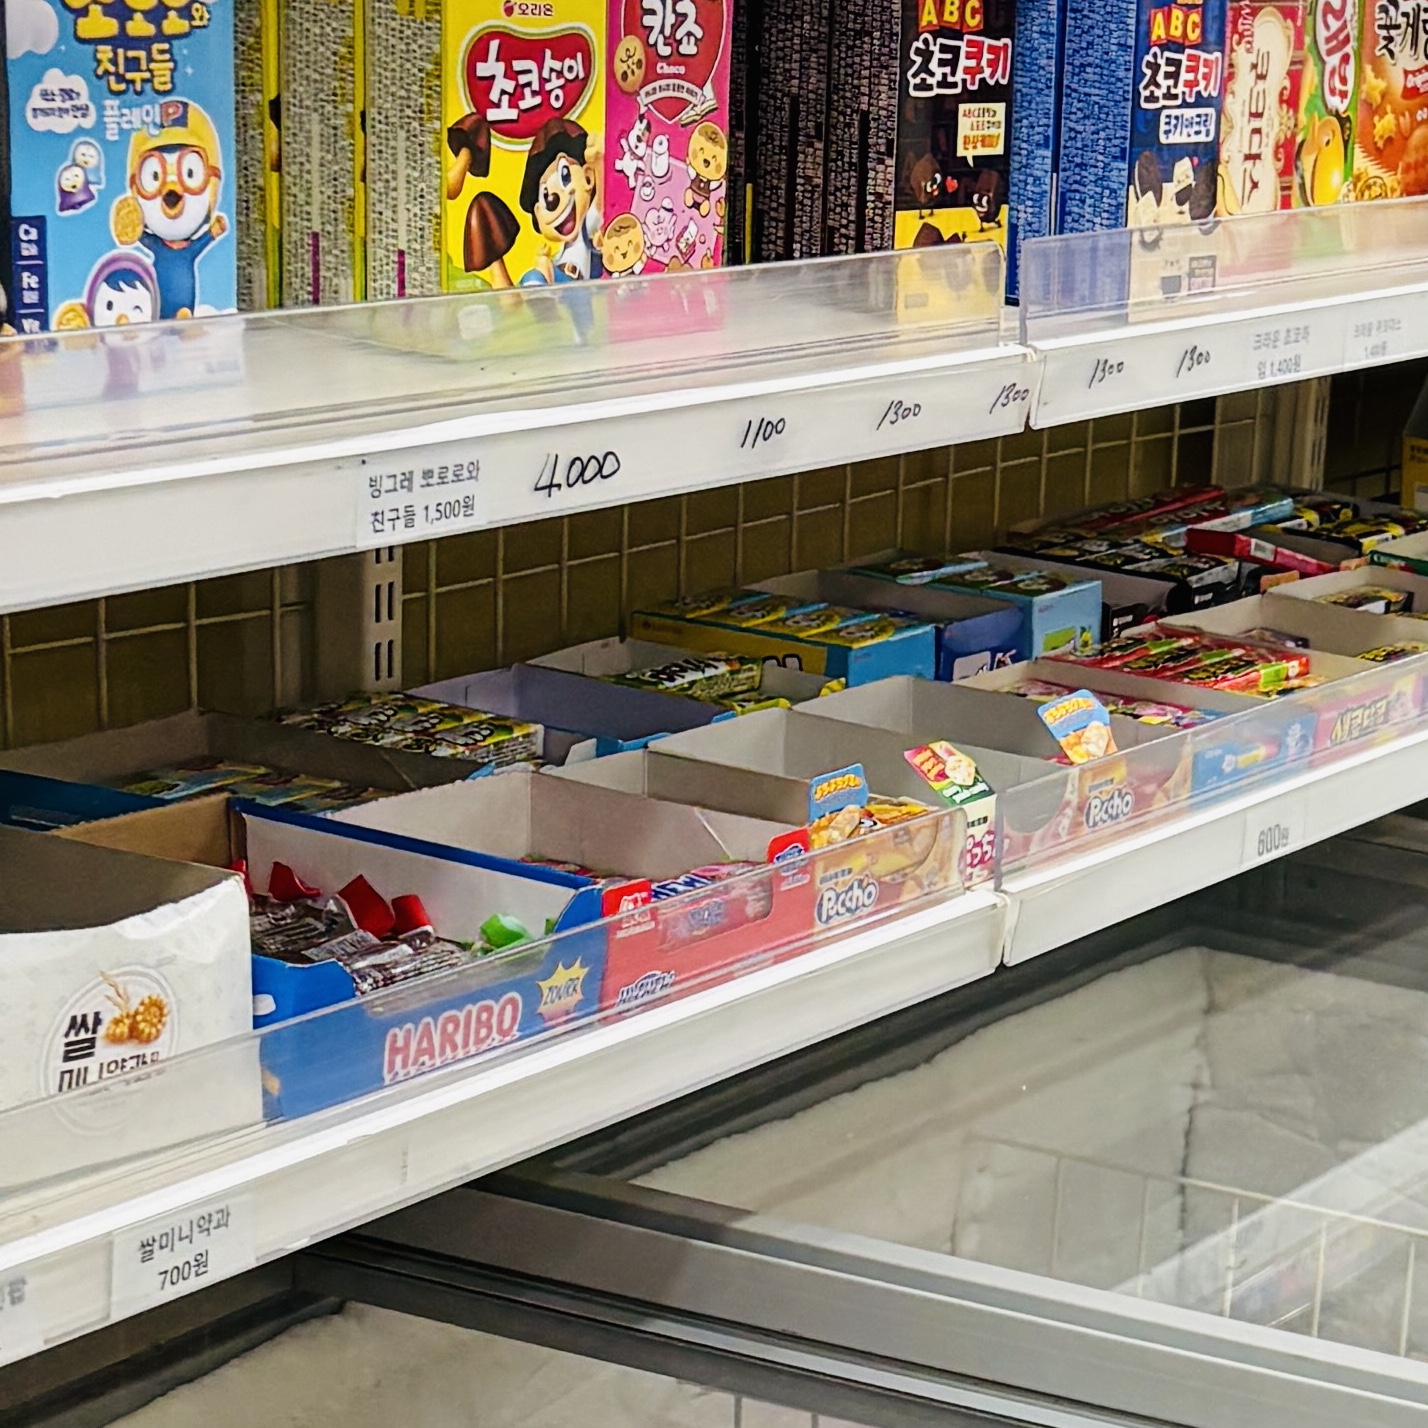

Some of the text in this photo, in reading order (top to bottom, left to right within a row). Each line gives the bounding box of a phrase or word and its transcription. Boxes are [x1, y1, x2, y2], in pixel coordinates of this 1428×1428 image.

[920, 0, 983, 28] ABC
[1152, 6, 1201, 40] ABC
[95, 43, 177, 94] 친구들
[476, 42, 587, 122] 초코송이
[911, 36, 1010, 94] 초코쿠키
[1142, 49, 1222, 106] 초코쿠키
[1088, 359, 1125, 389] 1300
[1176, 346, 1212, 378] 1300
[877, 400, 922, 431] 1300
[989, 383, 1031, 415] 1300
[368, 459, 482, 499] 빙그레 뽀로로와
[370, 495, 477, 533] 친구들 1,500원
[385, 995, 522, 1077] HARIBO
[137, 1205, 231, 1264] 쌀미니약과
[158, 1250, 210, 1291] 700원
